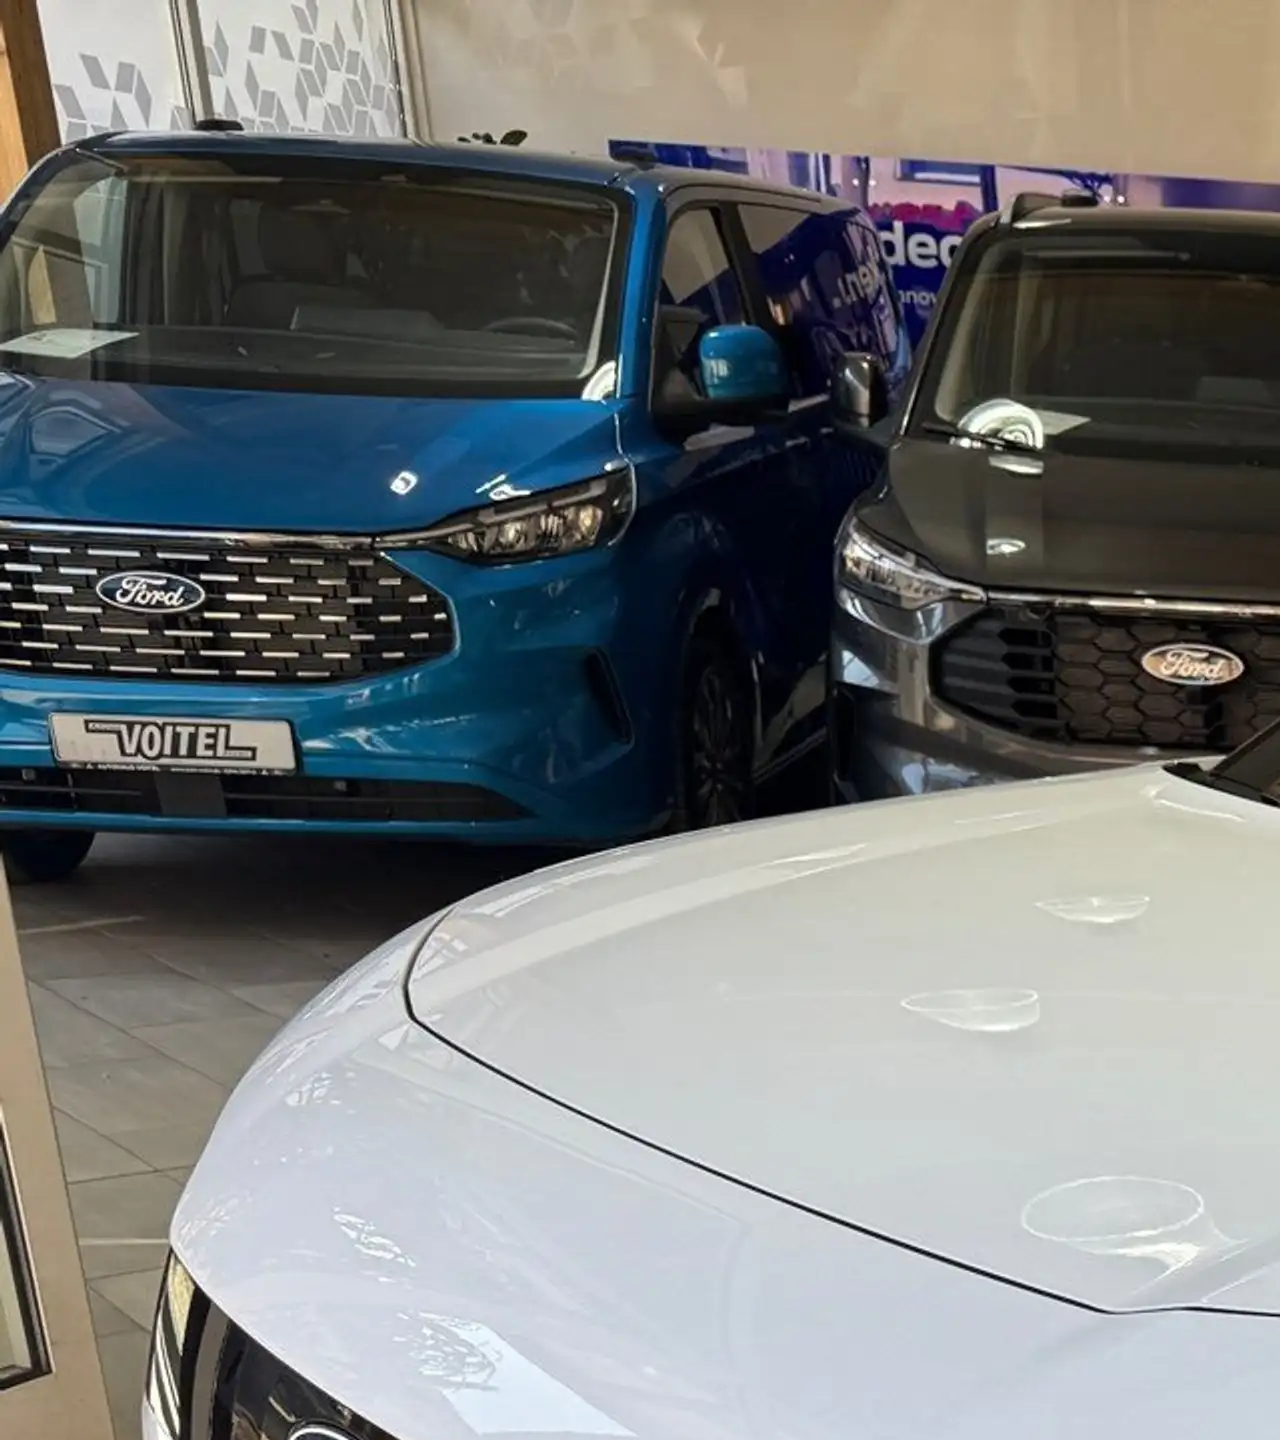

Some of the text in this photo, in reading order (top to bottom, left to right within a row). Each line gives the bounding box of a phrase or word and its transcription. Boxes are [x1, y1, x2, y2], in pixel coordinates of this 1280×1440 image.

[115, 575, 186, 607] Ford
[1159, 649, 1226, 679] Ford
[119, 721, 228, 761] VOITEL
